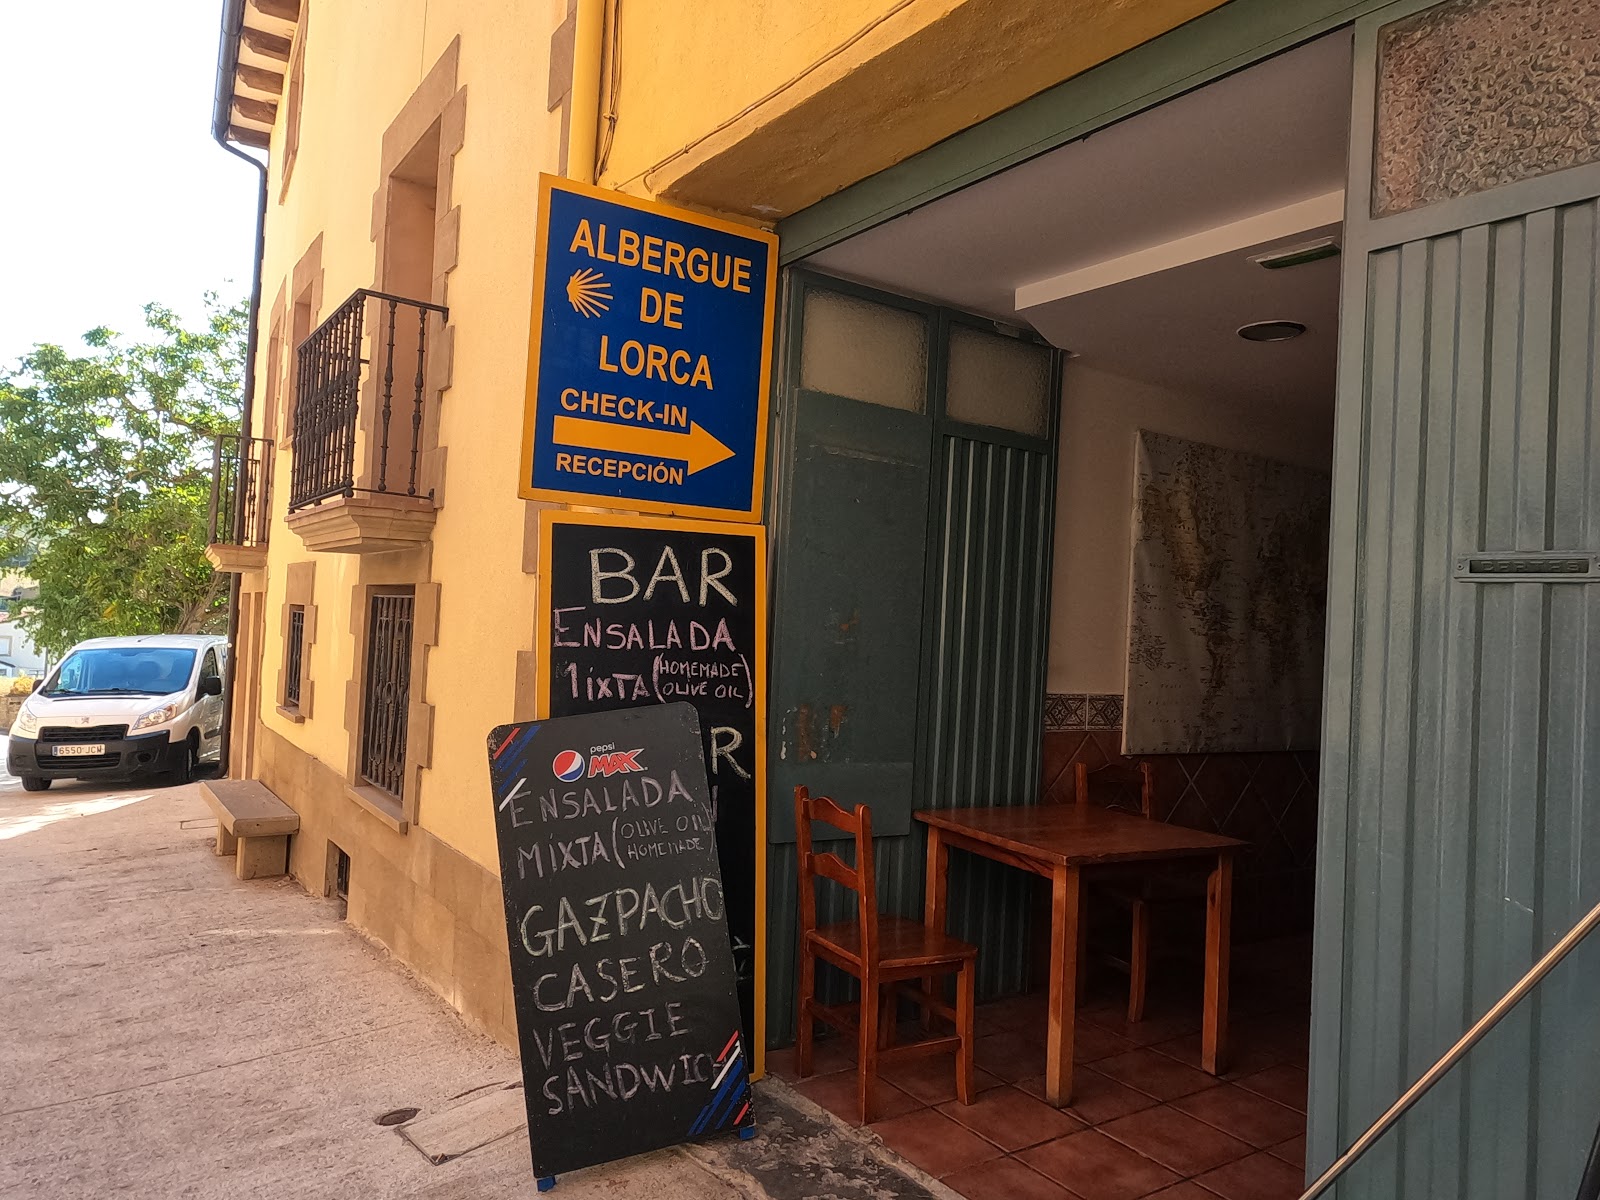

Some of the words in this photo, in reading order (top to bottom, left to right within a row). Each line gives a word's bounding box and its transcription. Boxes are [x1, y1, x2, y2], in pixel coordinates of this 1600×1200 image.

[569, 218, 752, 294] ALBERGUE
[639, 286, 684, 330] DE
[599, 335, 714, 391] LORCA
[560, 387, 687, 428] CHECK-IN
[555, 451, 683, 486] RECEPCIÓN
[589, 544, 738, 607] BAR
[553, 606, 736, 651] ENSALADA
[59, 746, 81, 755] 6550
[587, 748, 645, 778] MAX
[590, 742, 615, 754] pepsi
[510, 770, 694, 828] ENSALADA
[520, 877, 724, 958] GAZPACHO
[532, 937, 709, 1012] CASERO
[533, 1002, 689, 1069] VEGGIE
